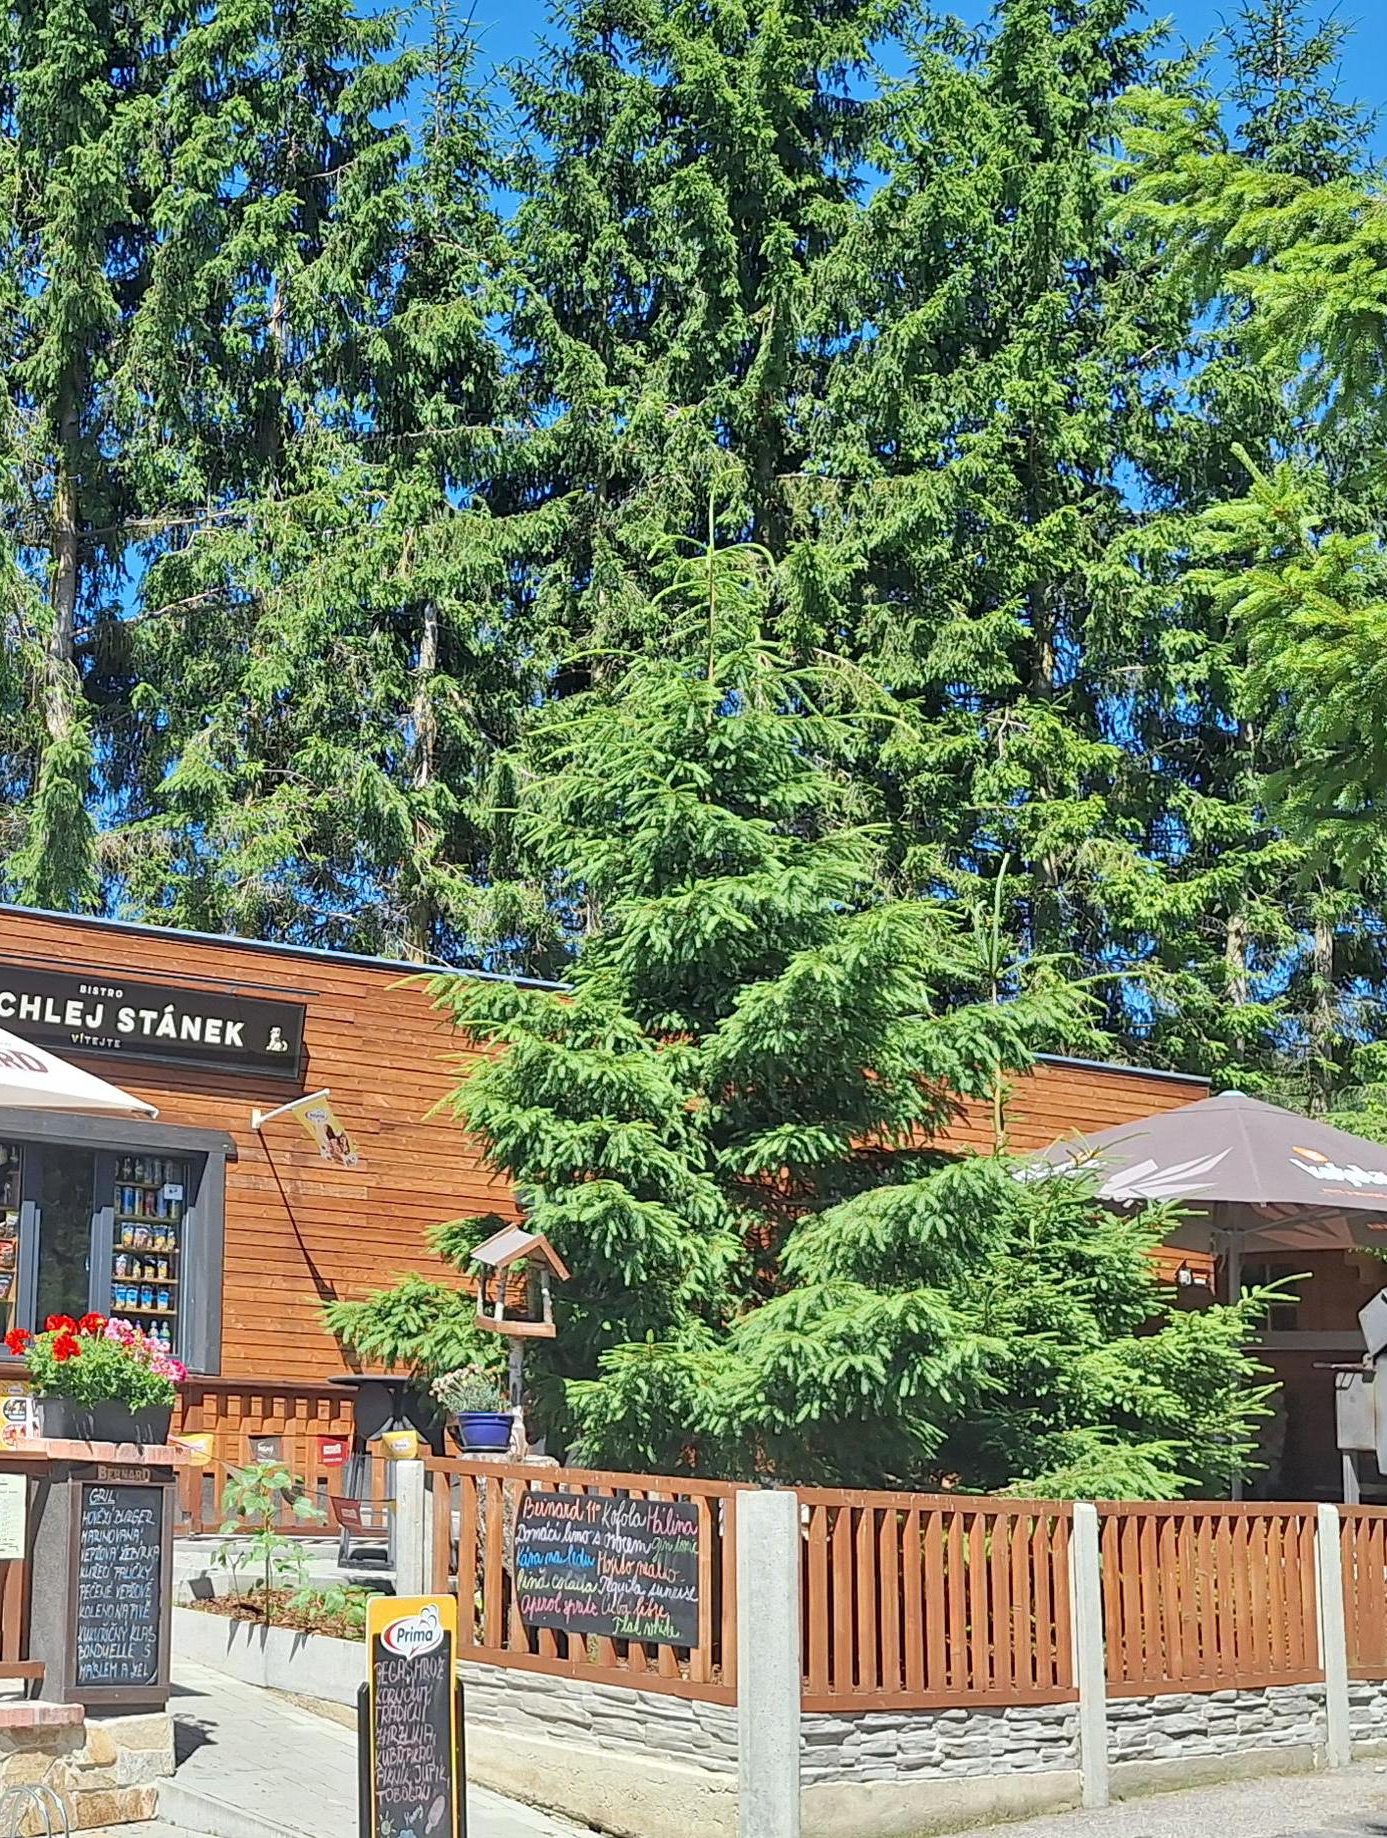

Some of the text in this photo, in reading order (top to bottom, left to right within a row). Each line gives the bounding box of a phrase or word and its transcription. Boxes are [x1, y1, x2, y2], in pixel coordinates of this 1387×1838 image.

[79, 984, 124, 999] BISTRO
[117, 1004, 246, 1048] STÁNEK
[71, 1033, 122, 1049] VÍTEJTE
[98, 1464, 151, 1482] BERNARD
[601, 1499, 647, 1538] Kofola
[396, 1625, 434, 1643] Prima
[78, 1641, 136, 1660] BONDUELLE
